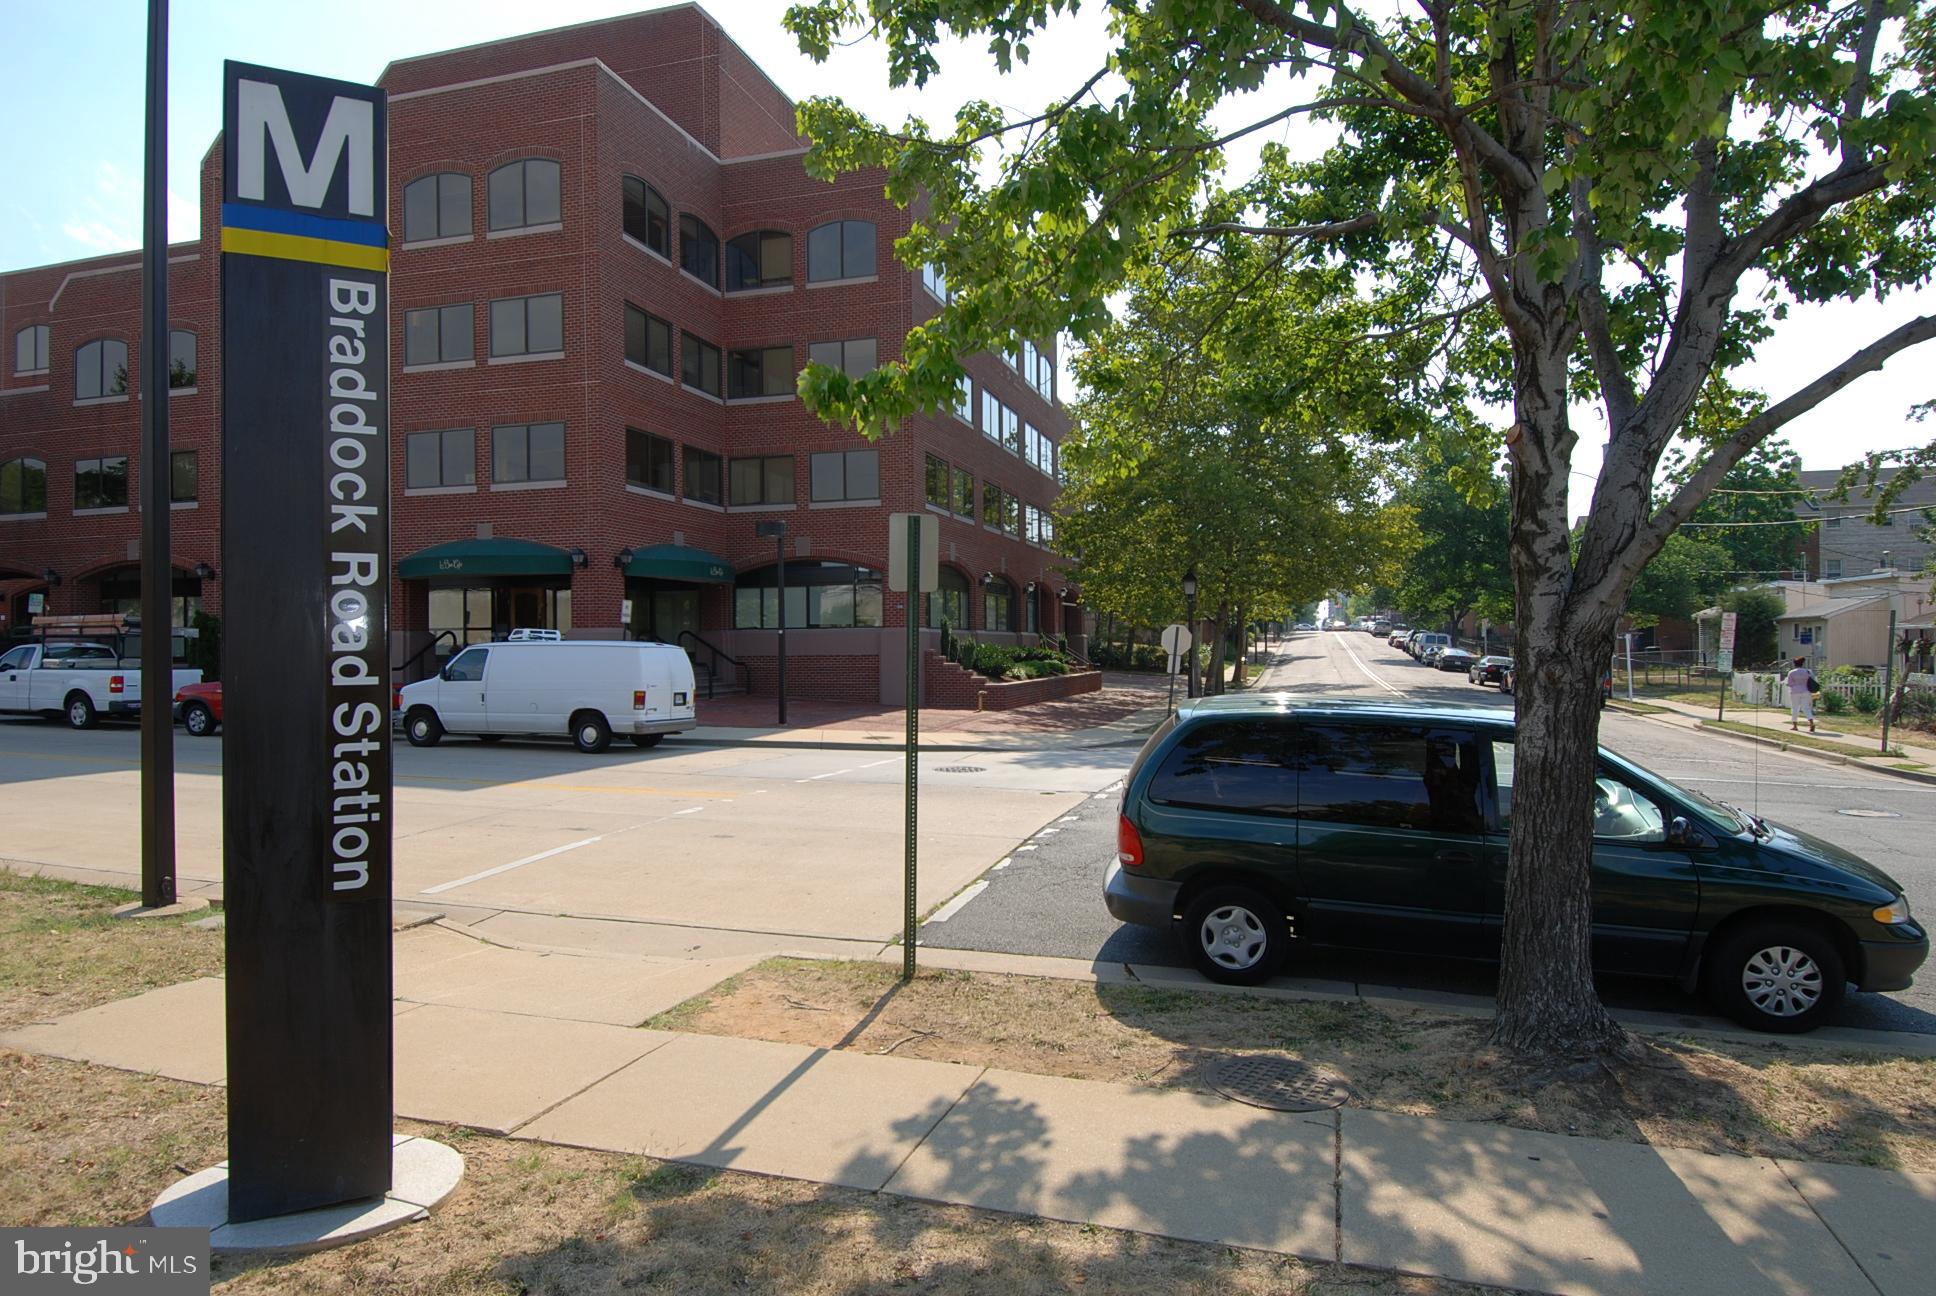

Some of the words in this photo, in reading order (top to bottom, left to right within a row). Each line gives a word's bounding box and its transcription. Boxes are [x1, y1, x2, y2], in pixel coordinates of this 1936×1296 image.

[237, 78, 374, 217] M
[328, 279, 378, 533] Braddock
[331, 552, 379, 686] Road
[332, 702, 381, 891] Station
